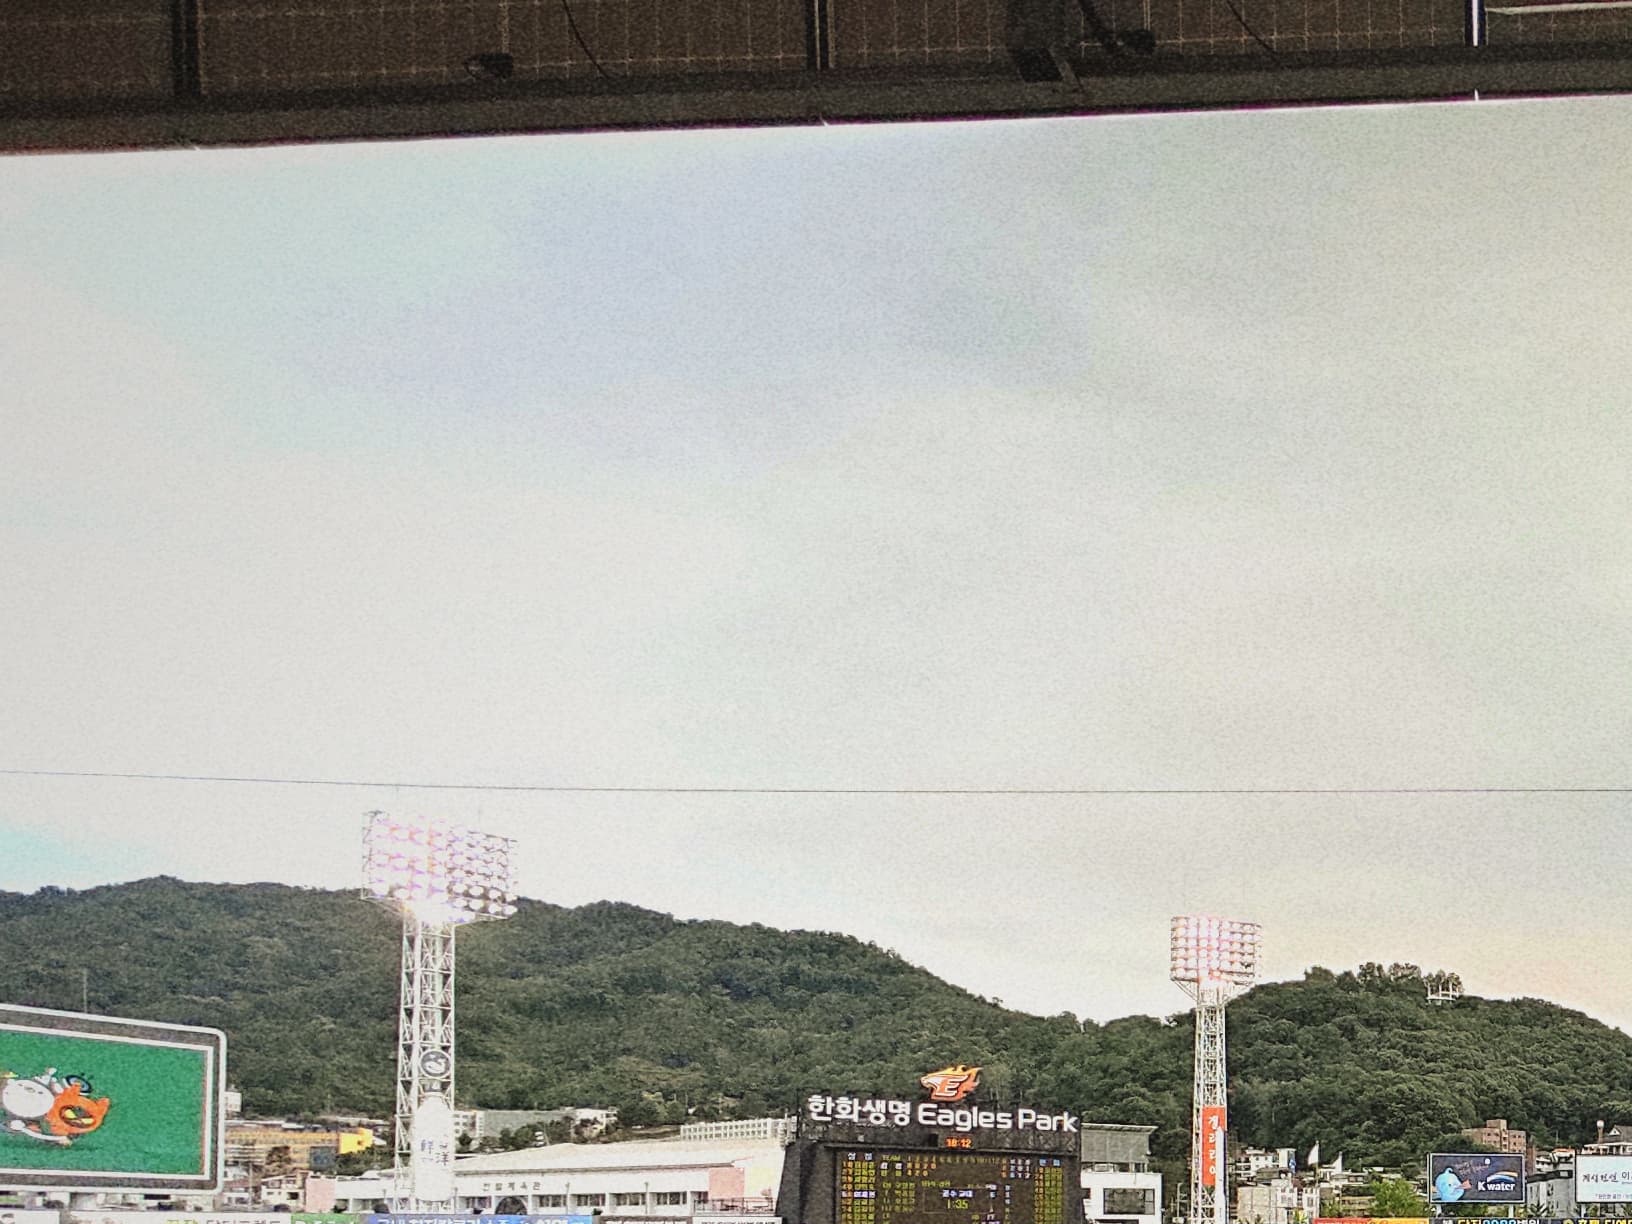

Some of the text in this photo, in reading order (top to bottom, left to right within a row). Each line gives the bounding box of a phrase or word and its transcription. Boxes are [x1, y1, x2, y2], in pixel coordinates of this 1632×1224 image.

[808, 1095, 1078, 1133] 한화생명 Eagles Park
